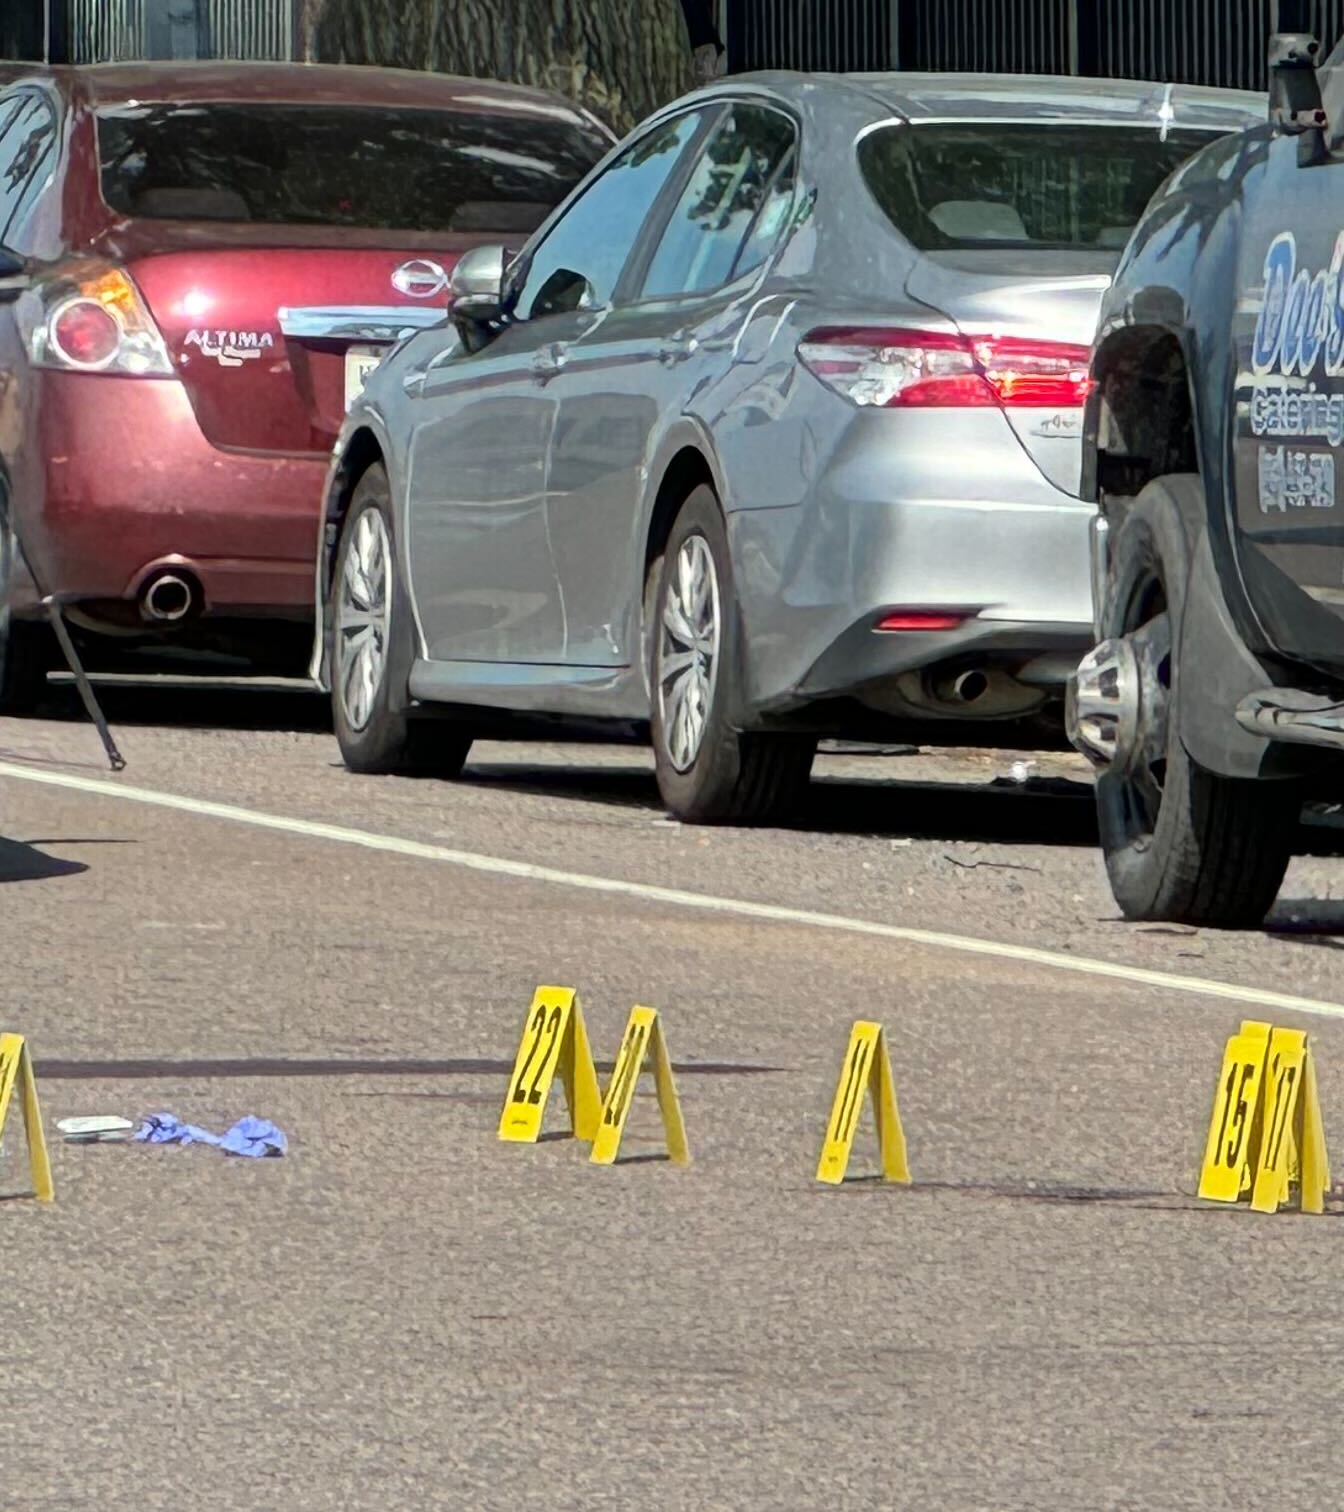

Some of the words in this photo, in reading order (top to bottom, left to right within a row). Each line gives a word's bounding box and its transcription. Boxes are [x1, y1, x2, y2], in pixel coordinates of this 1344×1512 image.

[183, 328, 274, 348] ALTIMA
[512, 1003, 562, 1105] 22
[1213, 1062, 1256, 1169] 15
